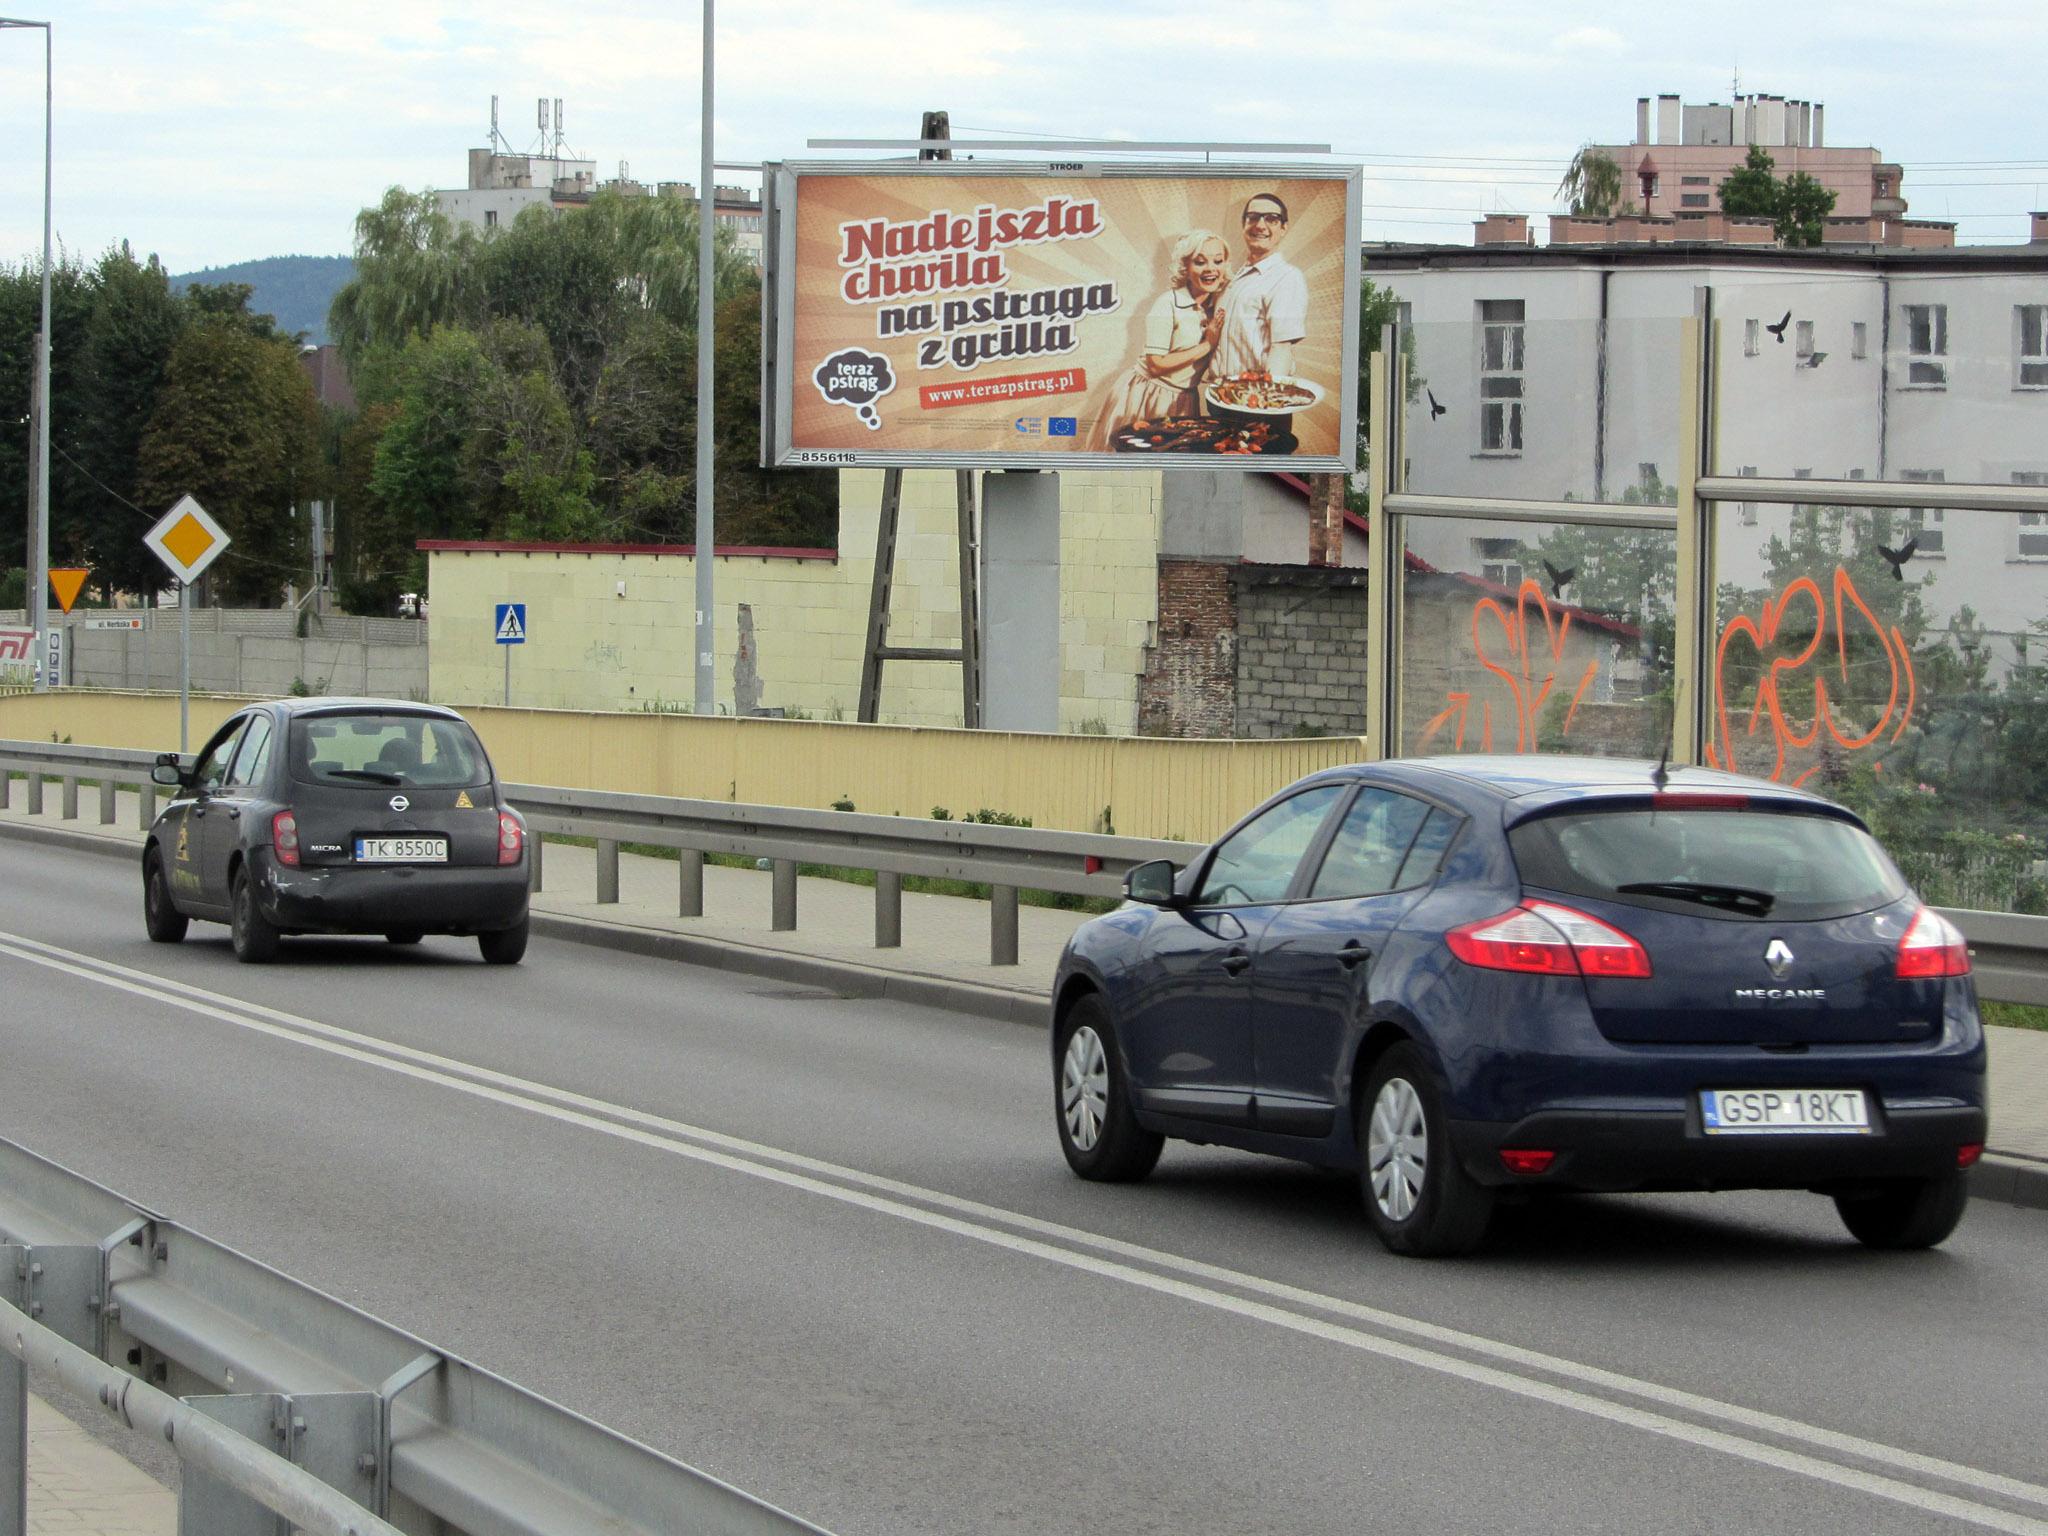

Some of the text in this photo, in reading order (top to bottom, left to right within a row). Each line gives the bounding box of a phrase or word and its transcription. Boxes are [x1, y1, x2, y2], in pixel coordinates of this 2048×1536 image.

[842, 198, 1102, 263] Nadejszła
[844, 251, 1007, 301] chwila
[880, 303, 938, 335] na
[920, 339, 946, 366] z
[837, 362, 875, 376] teraz
[828, 375, 879, 393] pstrąg
[928, 371, 1075, 403] www.terazpstrag.pl
[801, 452, 856, 463] 8556118
[367, 841, 444, 858] TK 8550C
[1735, 989, 1825, 1000] MEGANE
[1721, 1093, 1859, 1123] GSP 18KT
